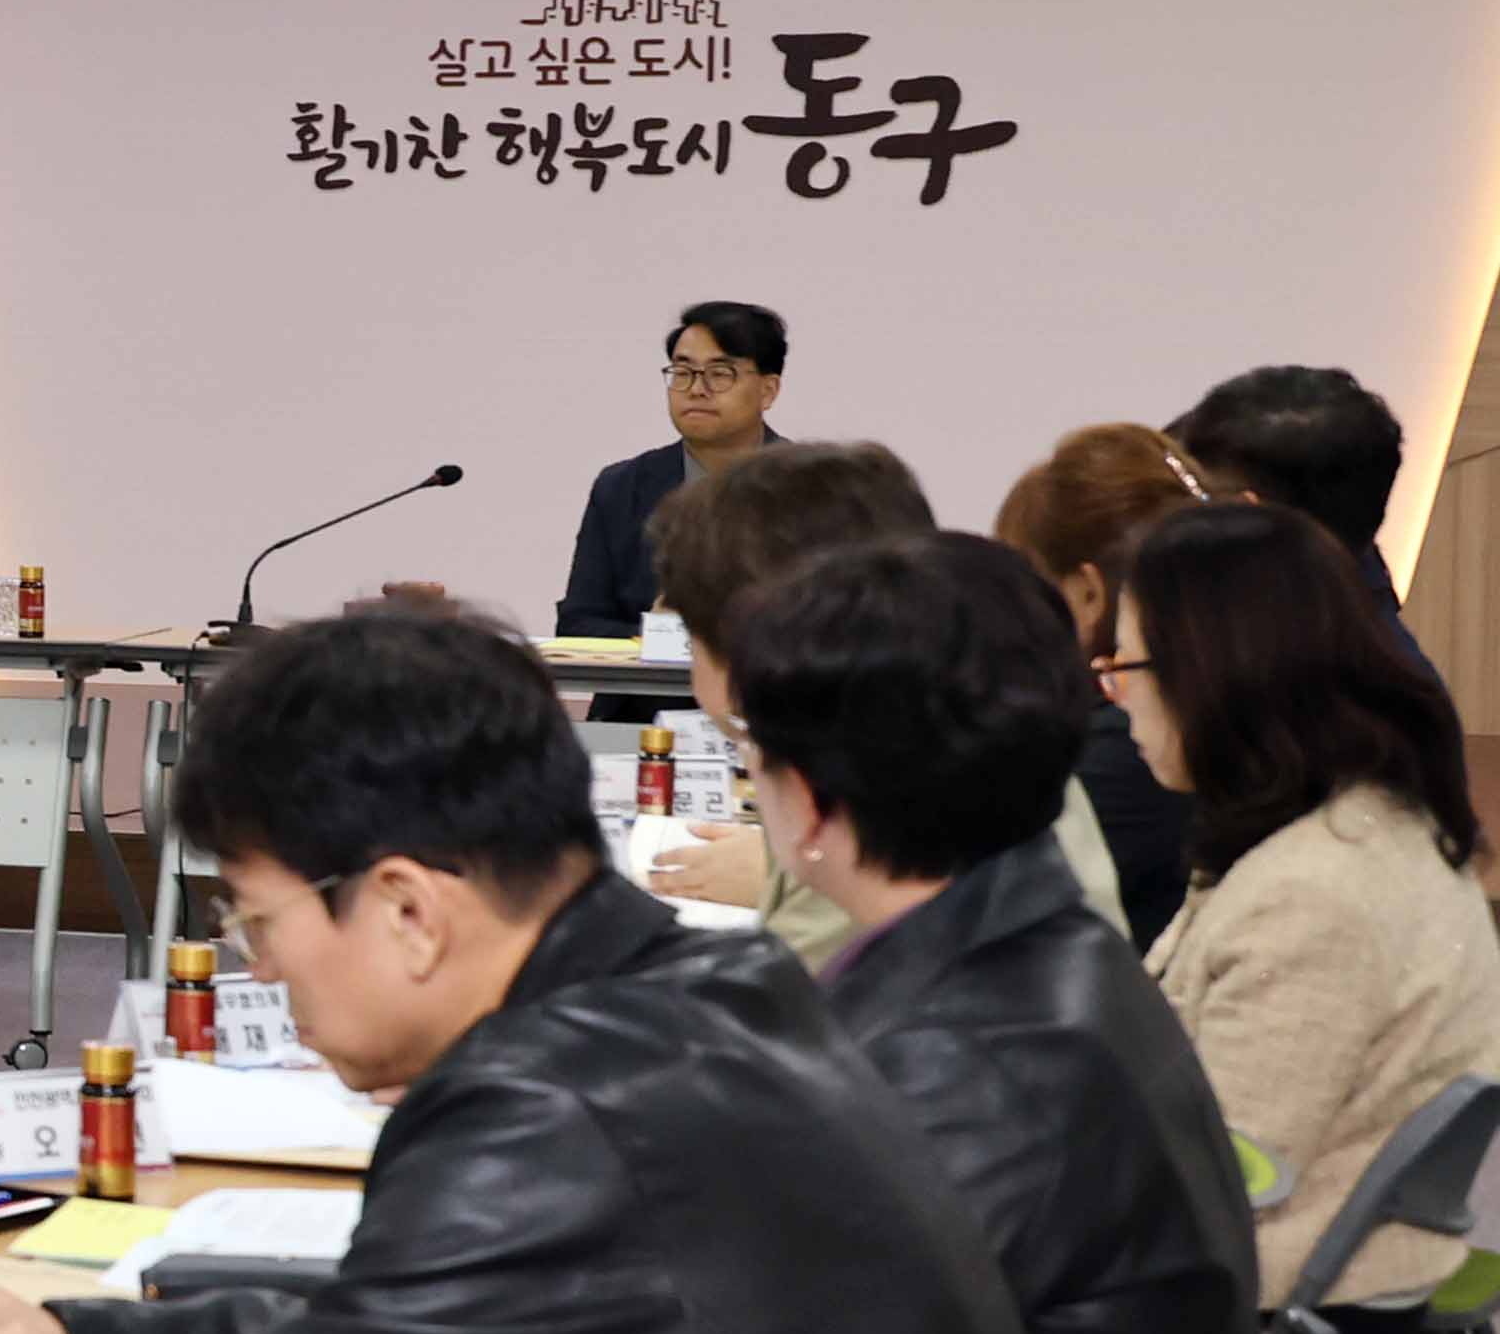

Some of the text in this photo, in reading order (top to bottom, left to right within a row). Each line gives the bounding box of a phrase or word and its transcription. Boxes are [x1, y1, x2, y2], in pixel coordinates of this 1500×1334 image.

[428, 36, 731, 87] 살고 싶은 도시!
[286, 32, 1018, 206] 활기찬 행복도시 동구
